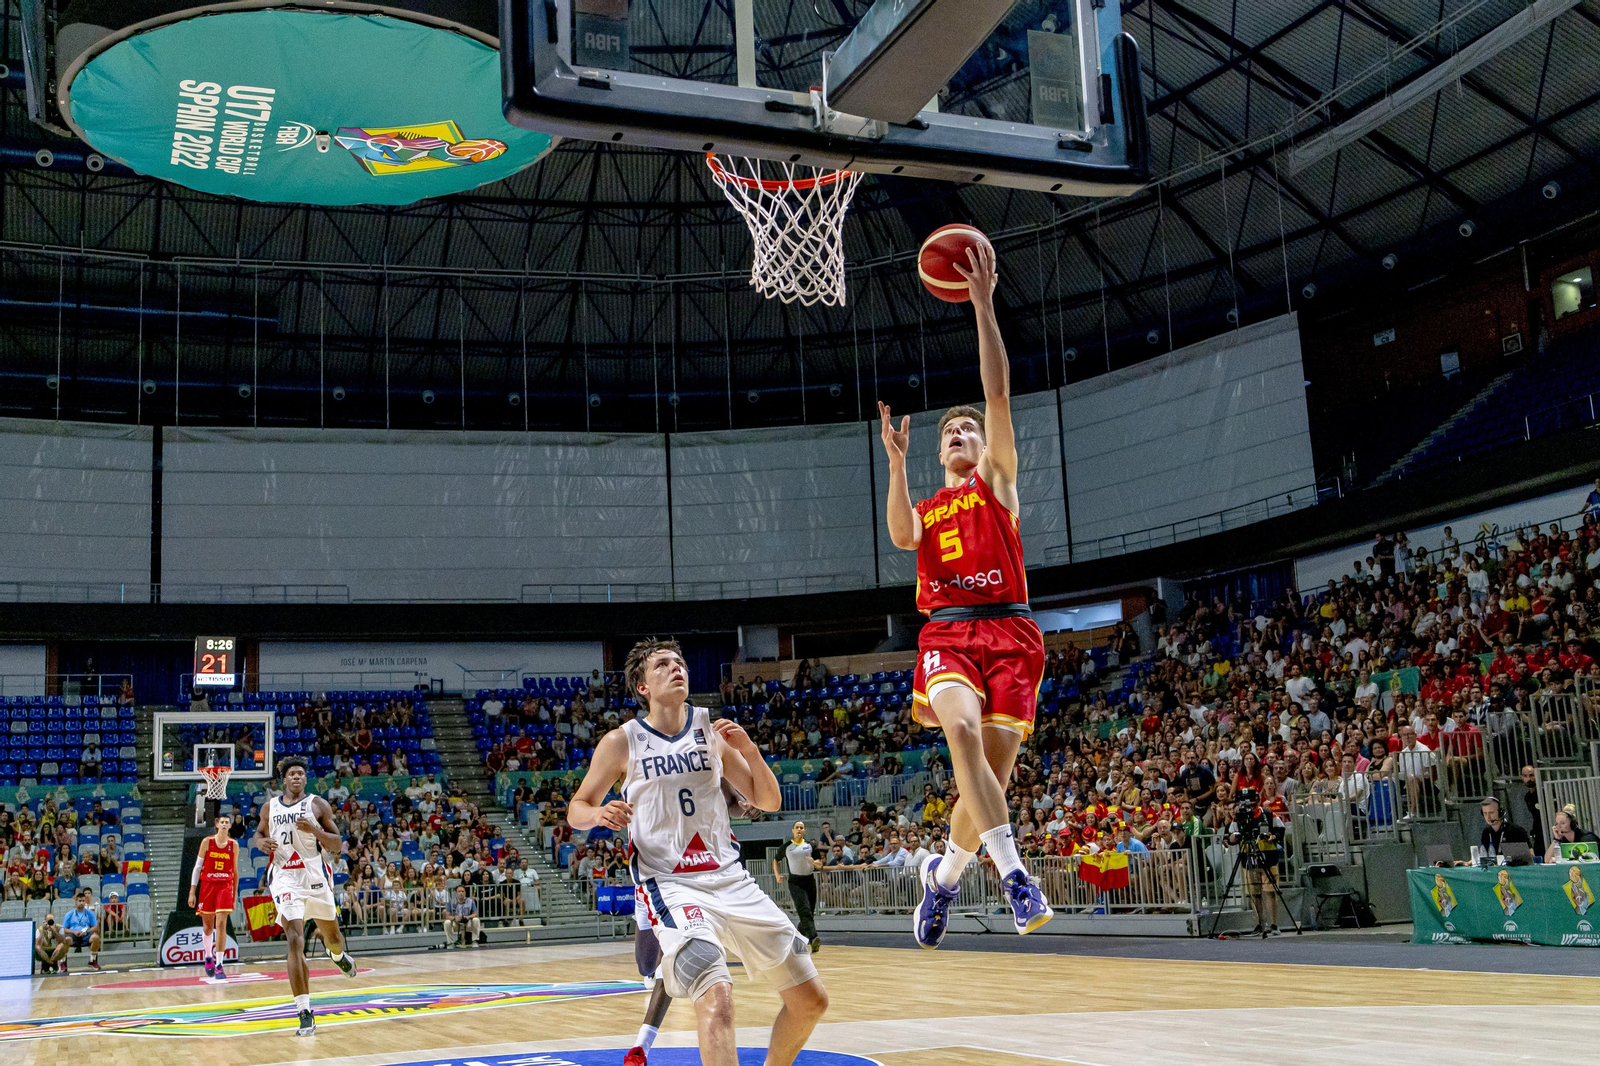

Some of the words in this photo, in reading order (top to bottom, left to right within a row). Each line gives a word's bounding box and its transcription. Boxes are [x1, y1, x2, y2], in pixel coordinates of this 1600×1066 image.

[175, 79, 222, 132] SPAIN
[224, 85, 276, 122] U17
[218, 121, 250, 155] WORLD
[276, 126, 301, 145] FIBA
[171, 131, 214, 170] 2022
[243, 122, 267, 175] BASKETBALL
[215, 155, 242, 174] CUP
[923, 492, 986, 529] SPAÑA
[939, 527, 964, 563] 5
[929, 568, 1003, 592] desa
[206, 639, 233, 650] 8:26
[201, 653, 227, 674] 21
[396, 657, 428, 666] CARPENA
[641, 750, 712, 780] FRANCE
[678, 788, 696, 817] 6
[281, 830, 294, 845] 21
[209, 851, 230, 859] ESPAÑA
[285, 859, 302, 868] MAIF
[679, 851, 712, 869] MAIF
[214, 861, 225, 870] 15
[176, 932, 216, 946] 百岁
[1561, 933, 1579, 945] U17
